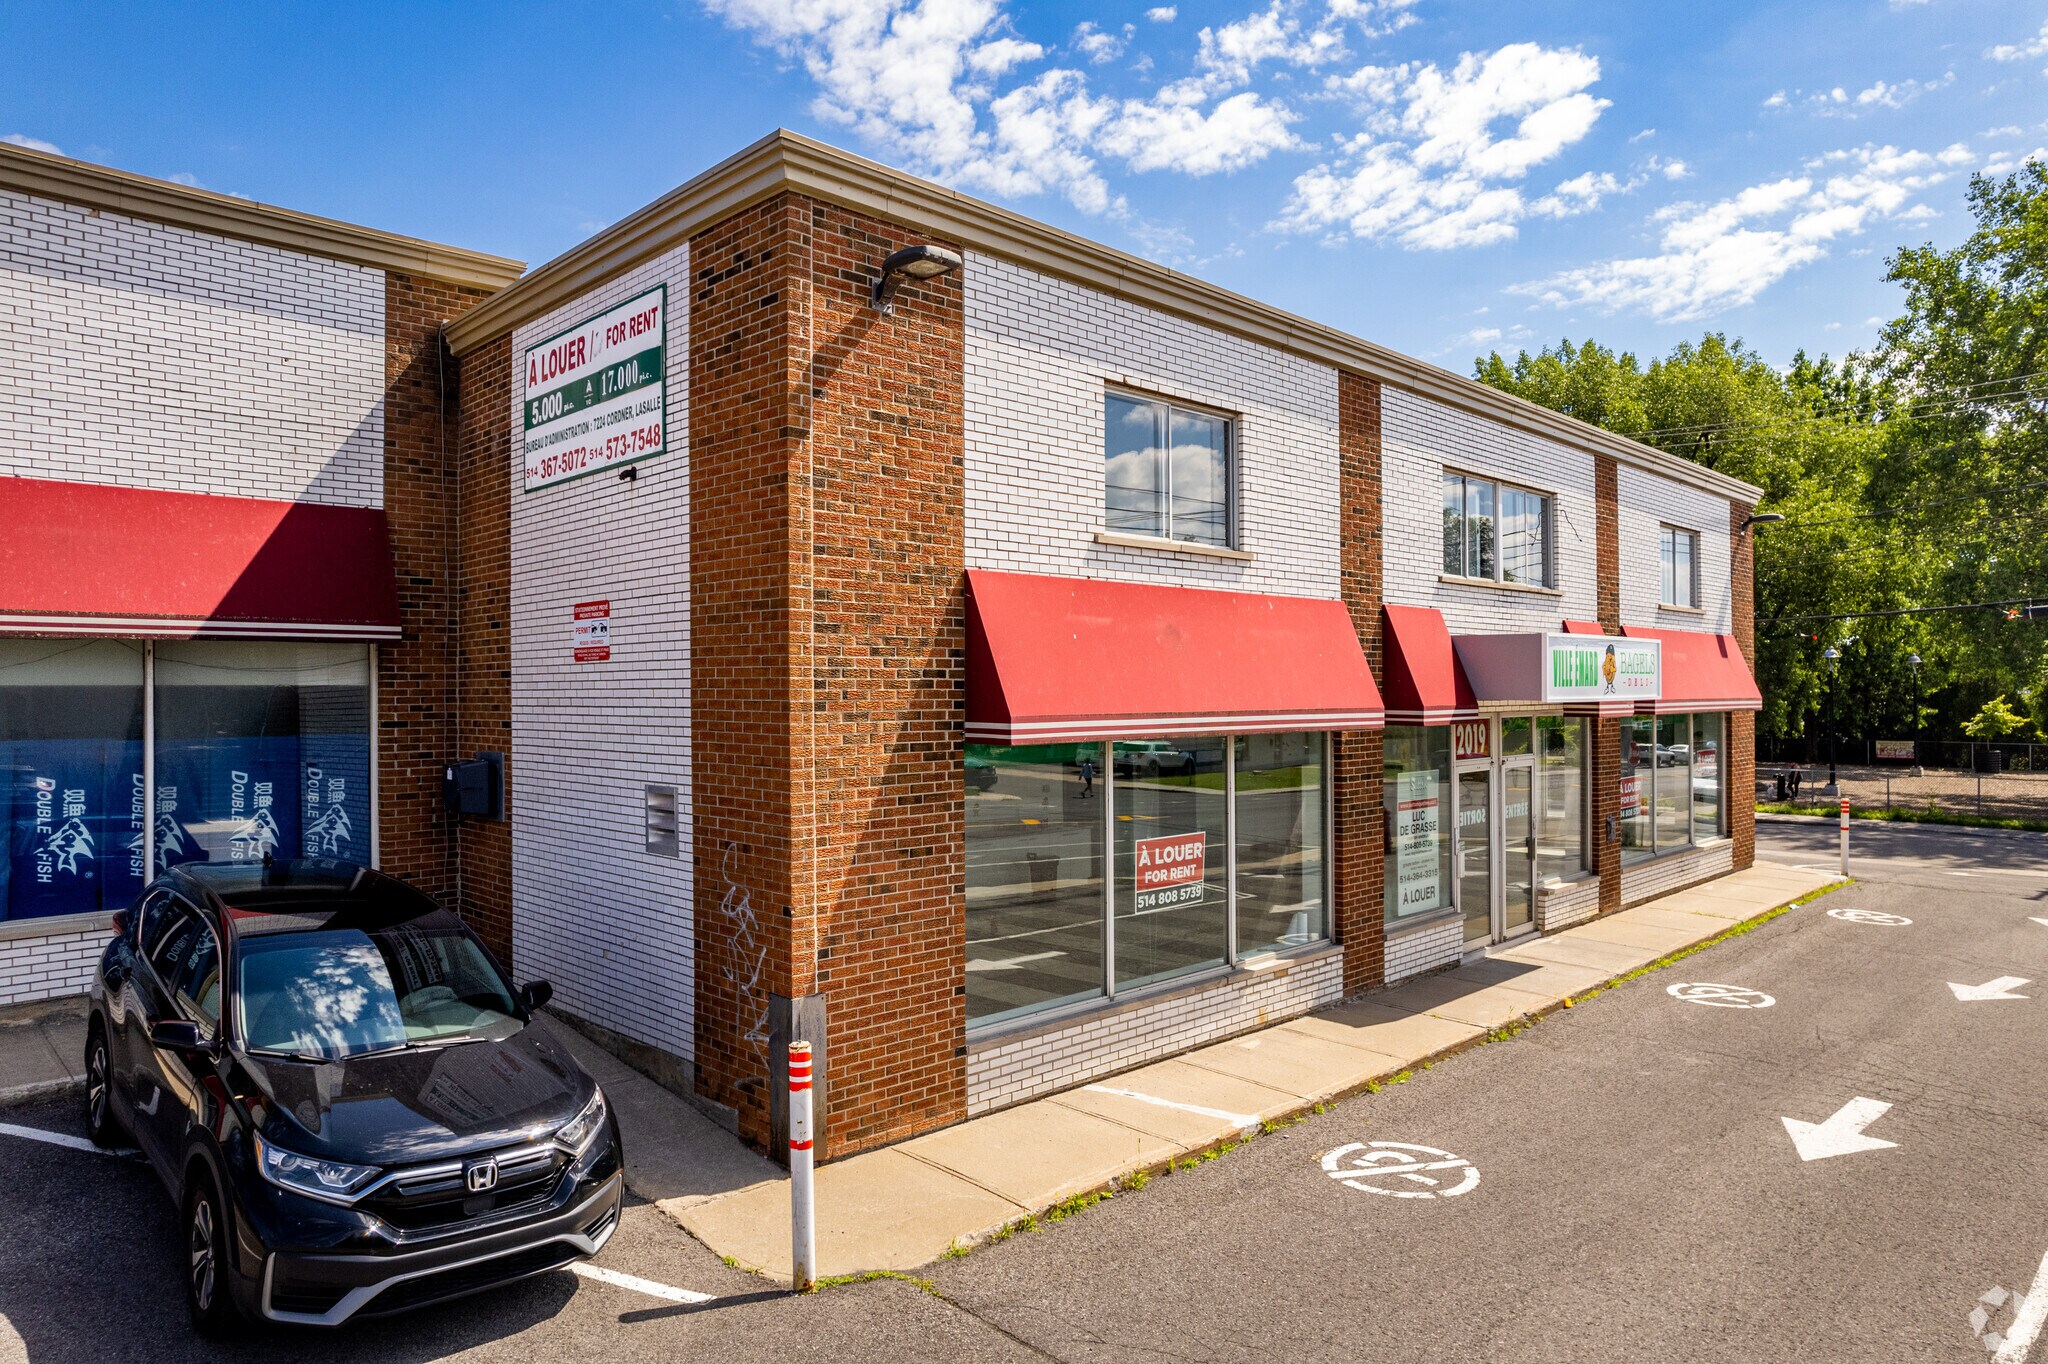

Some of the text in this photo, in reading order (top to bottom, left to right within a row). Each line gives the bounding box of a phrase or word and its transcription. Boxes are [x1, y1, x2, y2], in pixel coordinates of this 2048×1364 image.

[529, 352, 537, 388] À
[541, 335, 586, 383] LOUER
[606, 321, 626, 349] FOR
[629, 306, 658, 339] RENT
[532, 391, 562, 425] 5.000
[601, 360, 638, 396] 17.000
[526, 436, 544, 454] BUREAU
[544, 420, 589, 448] D'ADMINISTRATION
[606, 405, 635, 427] CORDNER,
[635, 396, 661, 417] LASALLE
[526, 423, 660, 479] 514 367-5072 514 573-7548
[1553, 644, 1656, 688] VILLE ÉMARD BAGELS
[1456, 723, 1486, 756] 2019
[231, 769, 249, 824] DOUBLE
[307, 766, 323, 819] DOUBLE
[36, 776, 56, 883] DOUBLE FISH
[130, 772, 145, 877] DOUBLE FISH
[1400, 825, 1410, 837] DE
[1410, 820, 1437, 835] GRASSE
[1412, 810, 1426, 822] LUC
[1138, 842, 1203, 867] À LOUER
[1145, 864, 1197, 884] FOR RENT
[1399, 868, 1438, 884] 514-364-3315
[1137, 884, 1202, 909] 514 808 5739
[1402, 885, 1436, 906] À LOUER
